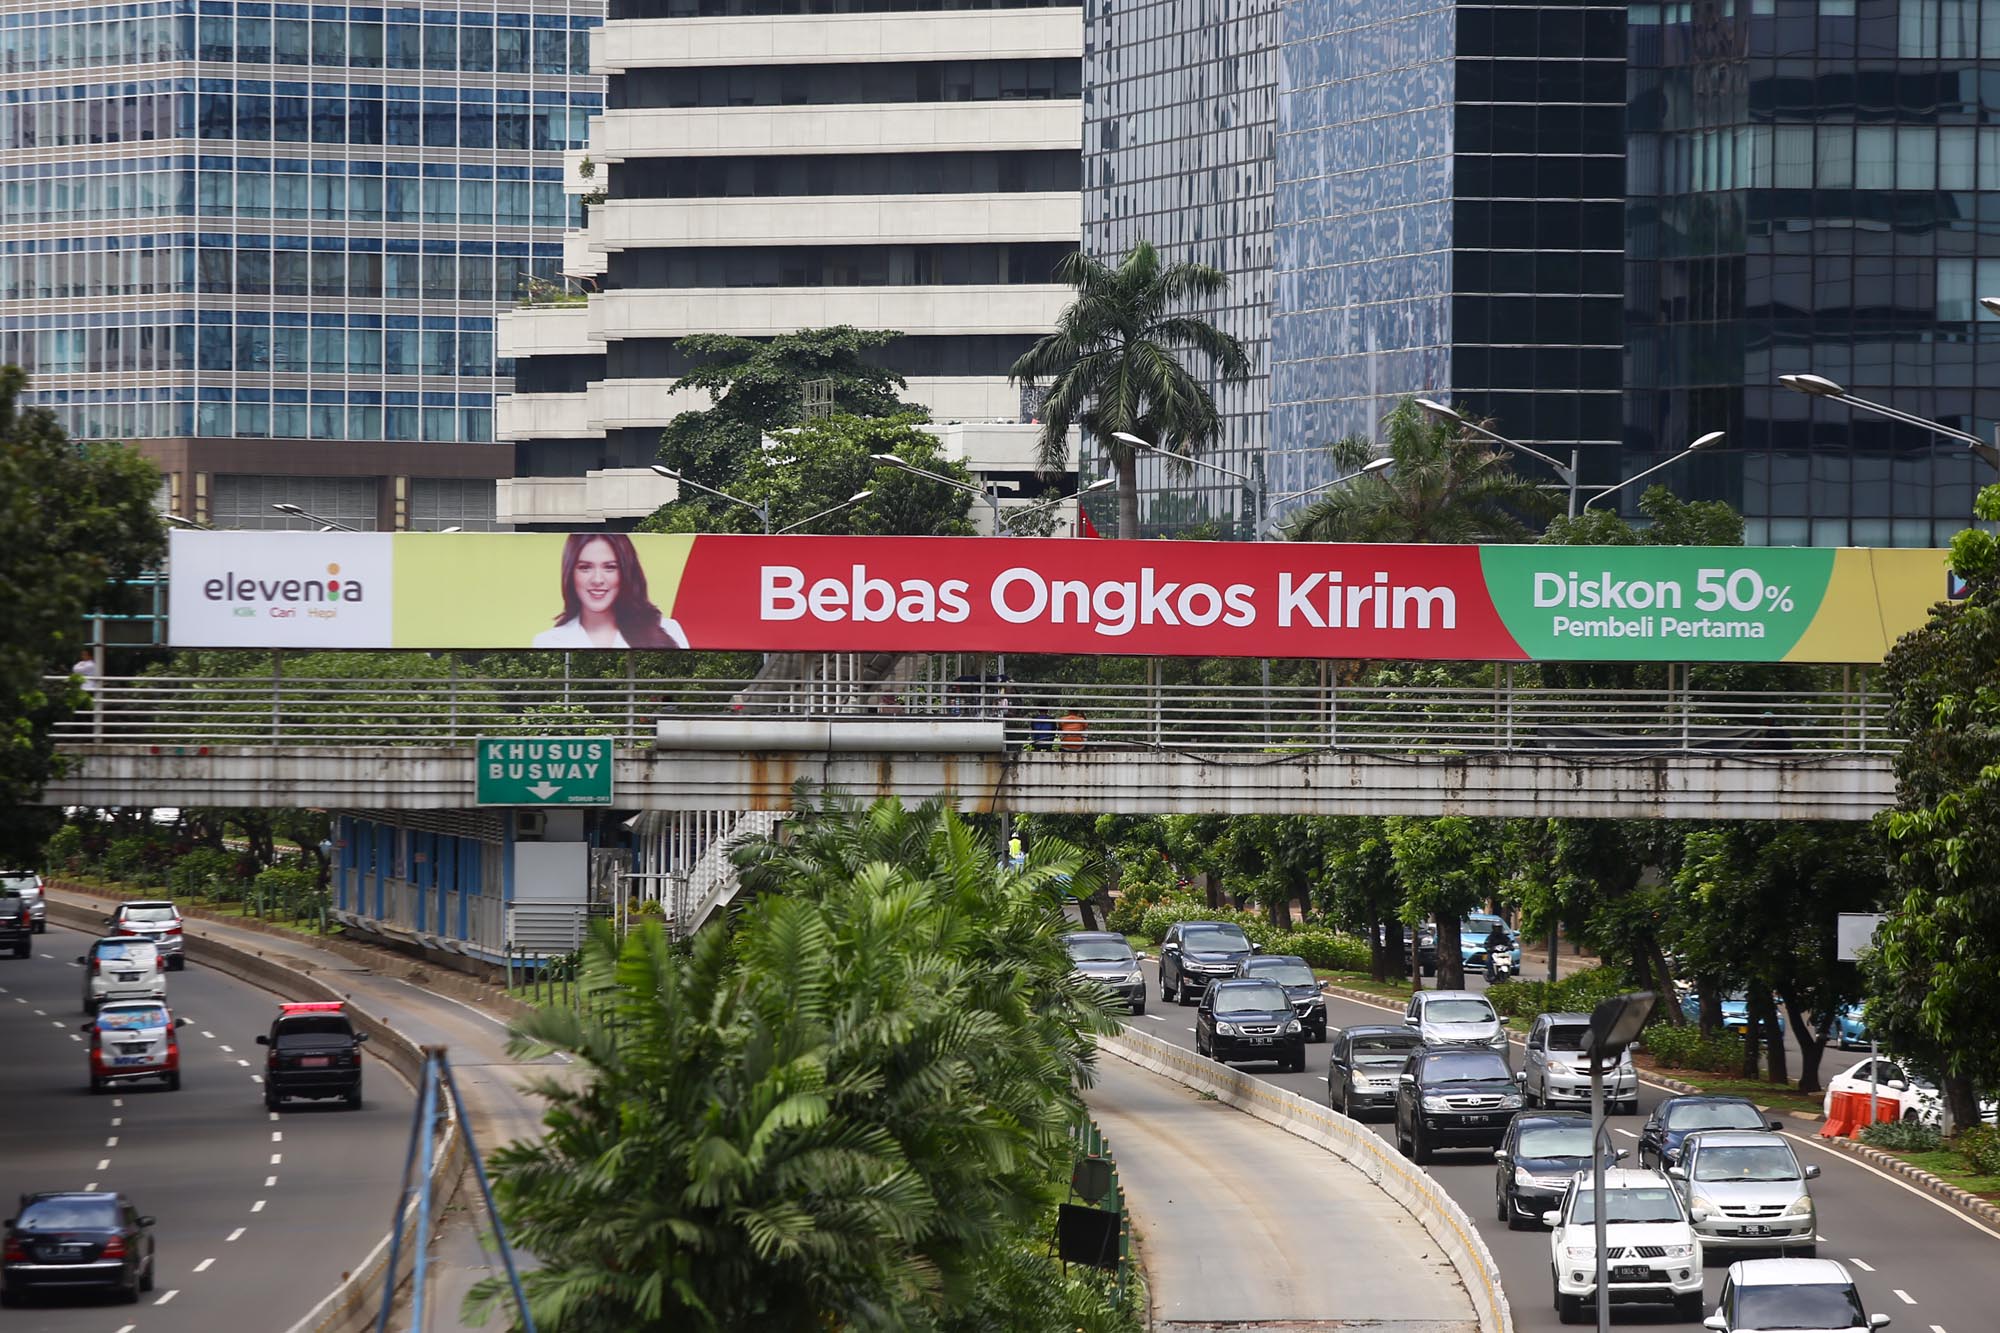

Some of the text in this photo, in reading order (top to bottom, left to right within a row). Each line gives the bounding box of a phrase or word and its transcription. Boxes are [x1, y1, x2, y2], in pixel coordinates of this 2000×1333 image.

[204, 563, 363, 601] elevenia
[1533, 568, 1794, 612] Diskon 50%
[760, 564, 1456, 636] Bebas Ongkos Kirim
[269, 606, 297, 618] Cari
[1553, 615, 1765, 638] Pembeli Pertama
[487, 743, 602, 760] KHUSUS
[488, 763, 599, 779] BUSWAY
